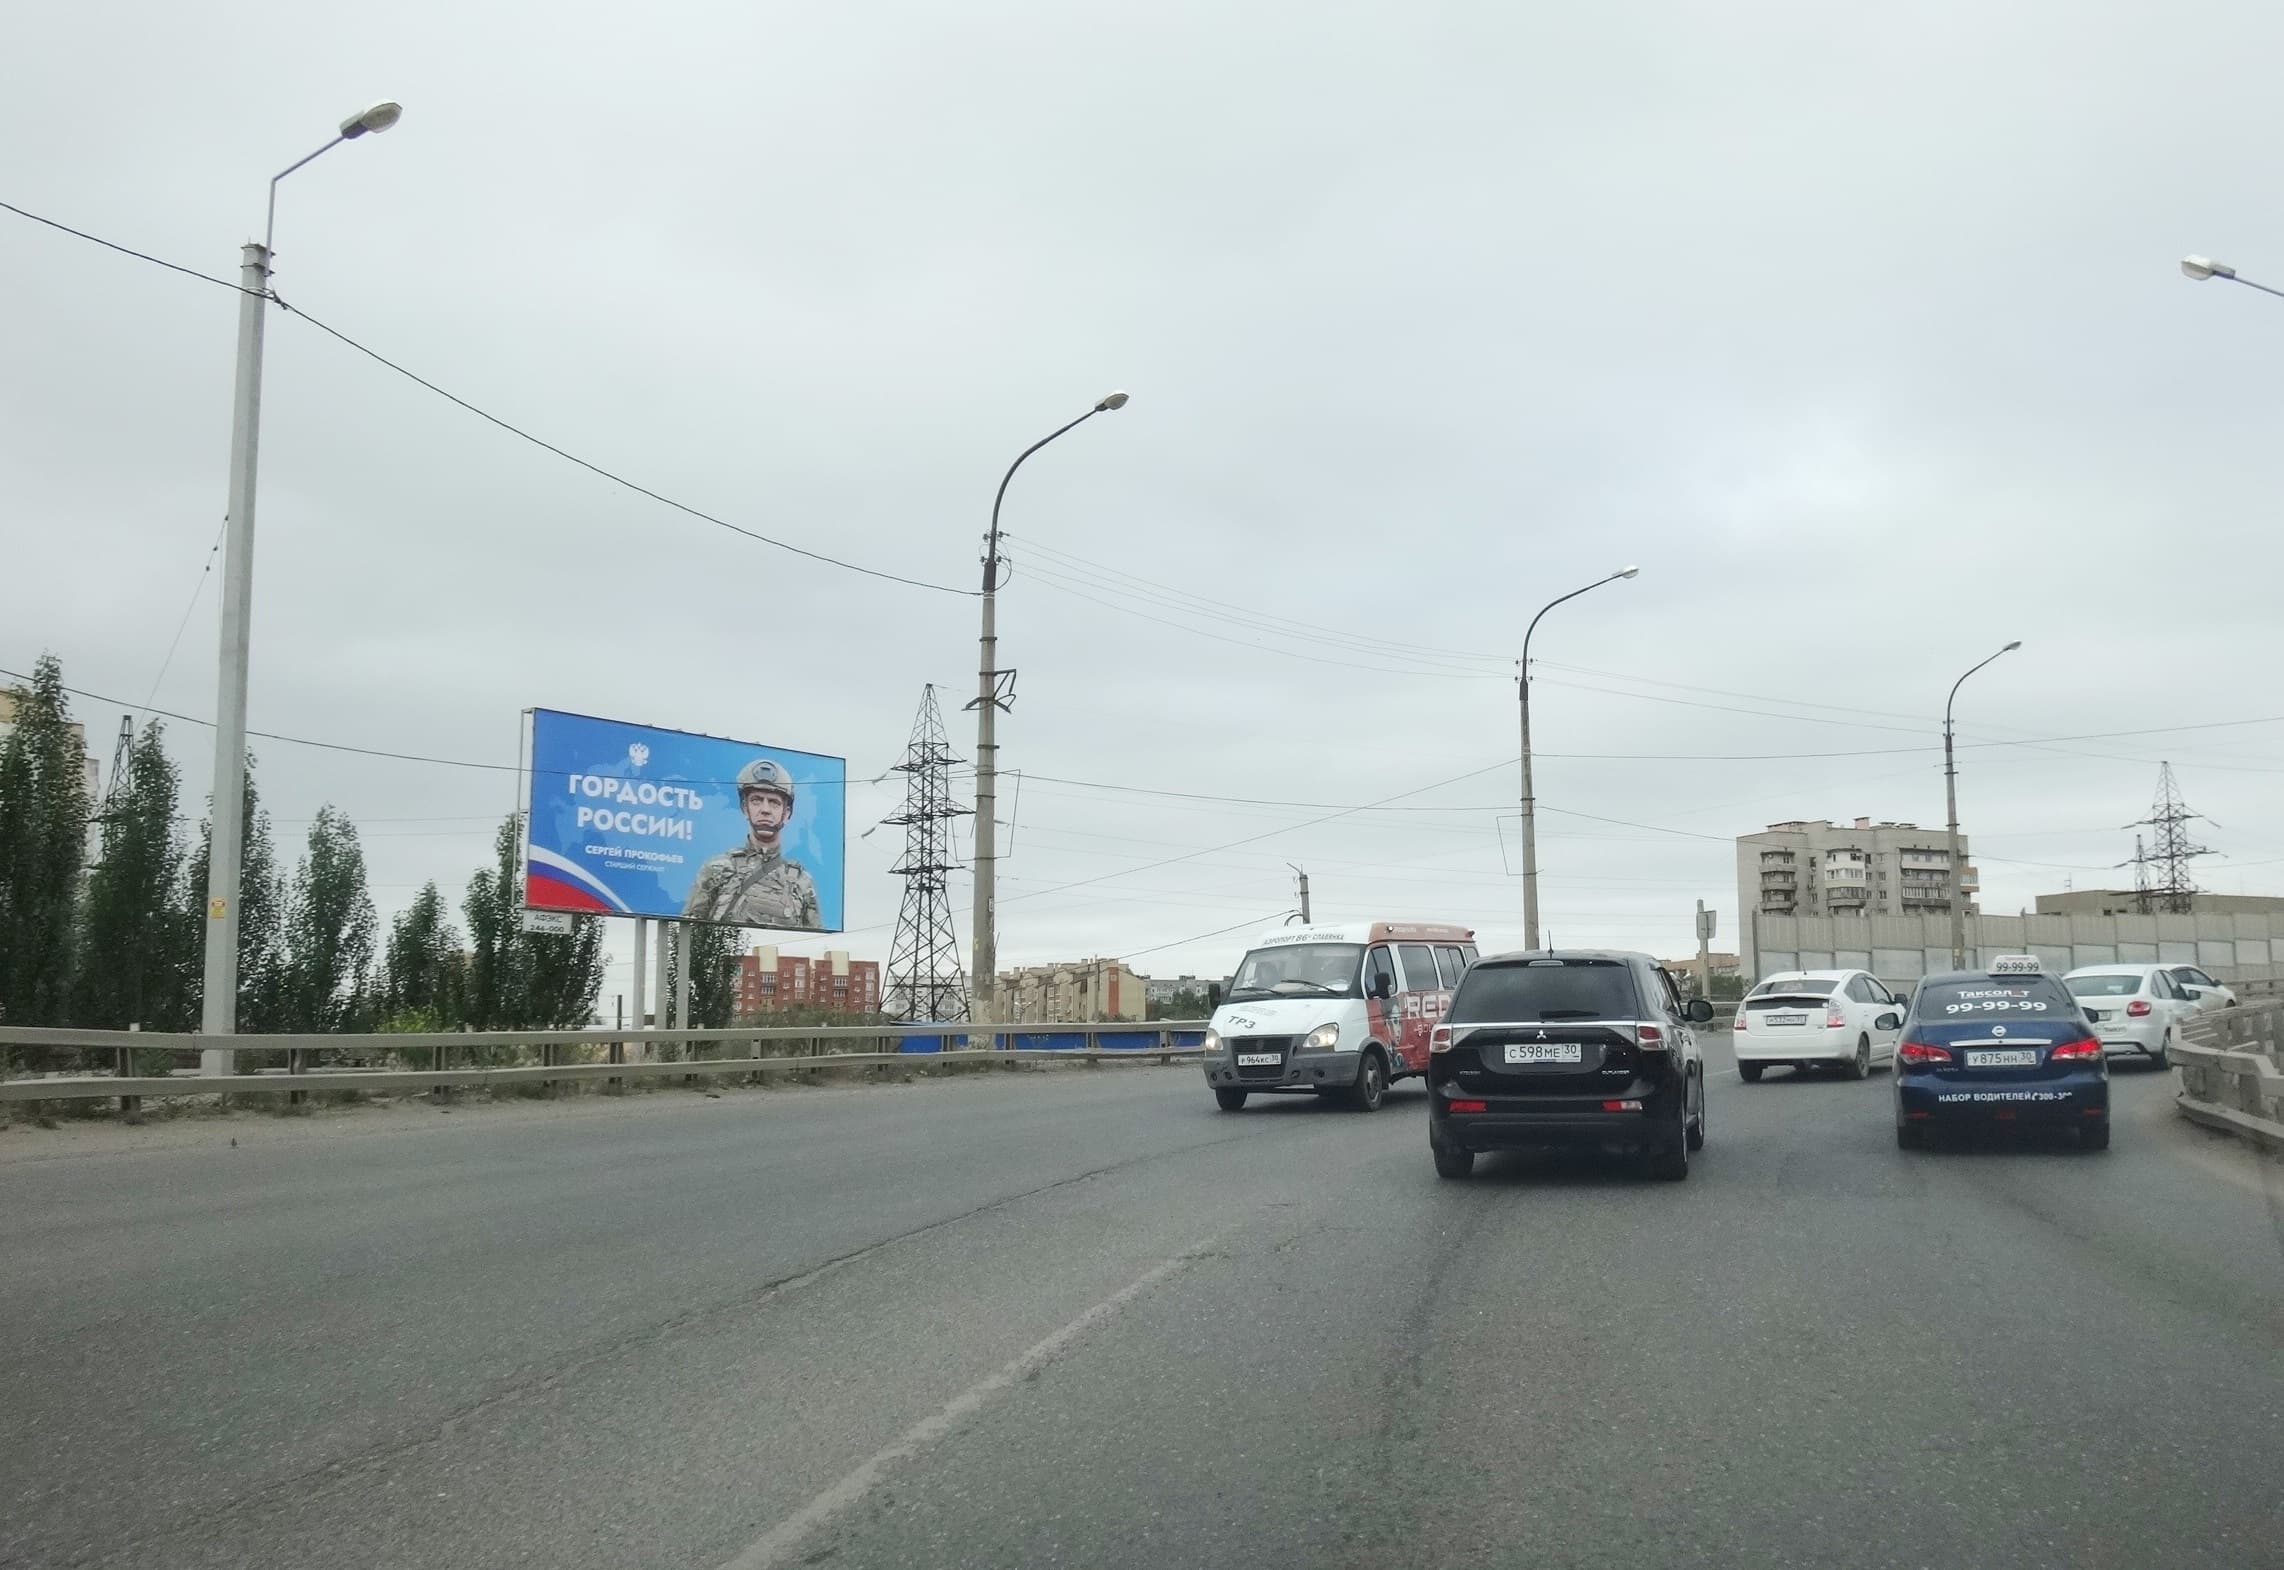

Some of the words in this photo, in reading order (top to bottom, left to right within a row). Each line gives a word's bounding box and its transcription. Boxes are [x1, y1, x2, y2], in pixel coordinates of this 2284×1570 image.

[569, 774, 704, 811] ГОРДОСТЬ
[577, 806, 693, 840] РОССИИ!
[585, 845, 622, 857] СЕРГЕЙ
[1996, 962, 2040, 972] 99-99-99
[1945, 1001, 2048, 1015] 99-99-99
[1564, 1044, 1577, 1055] 30
[1938, 1093, 1972, 1103] НАБОР
[1973, 1091, 2032, 1103] ВОДИТЕЛЕЙ
